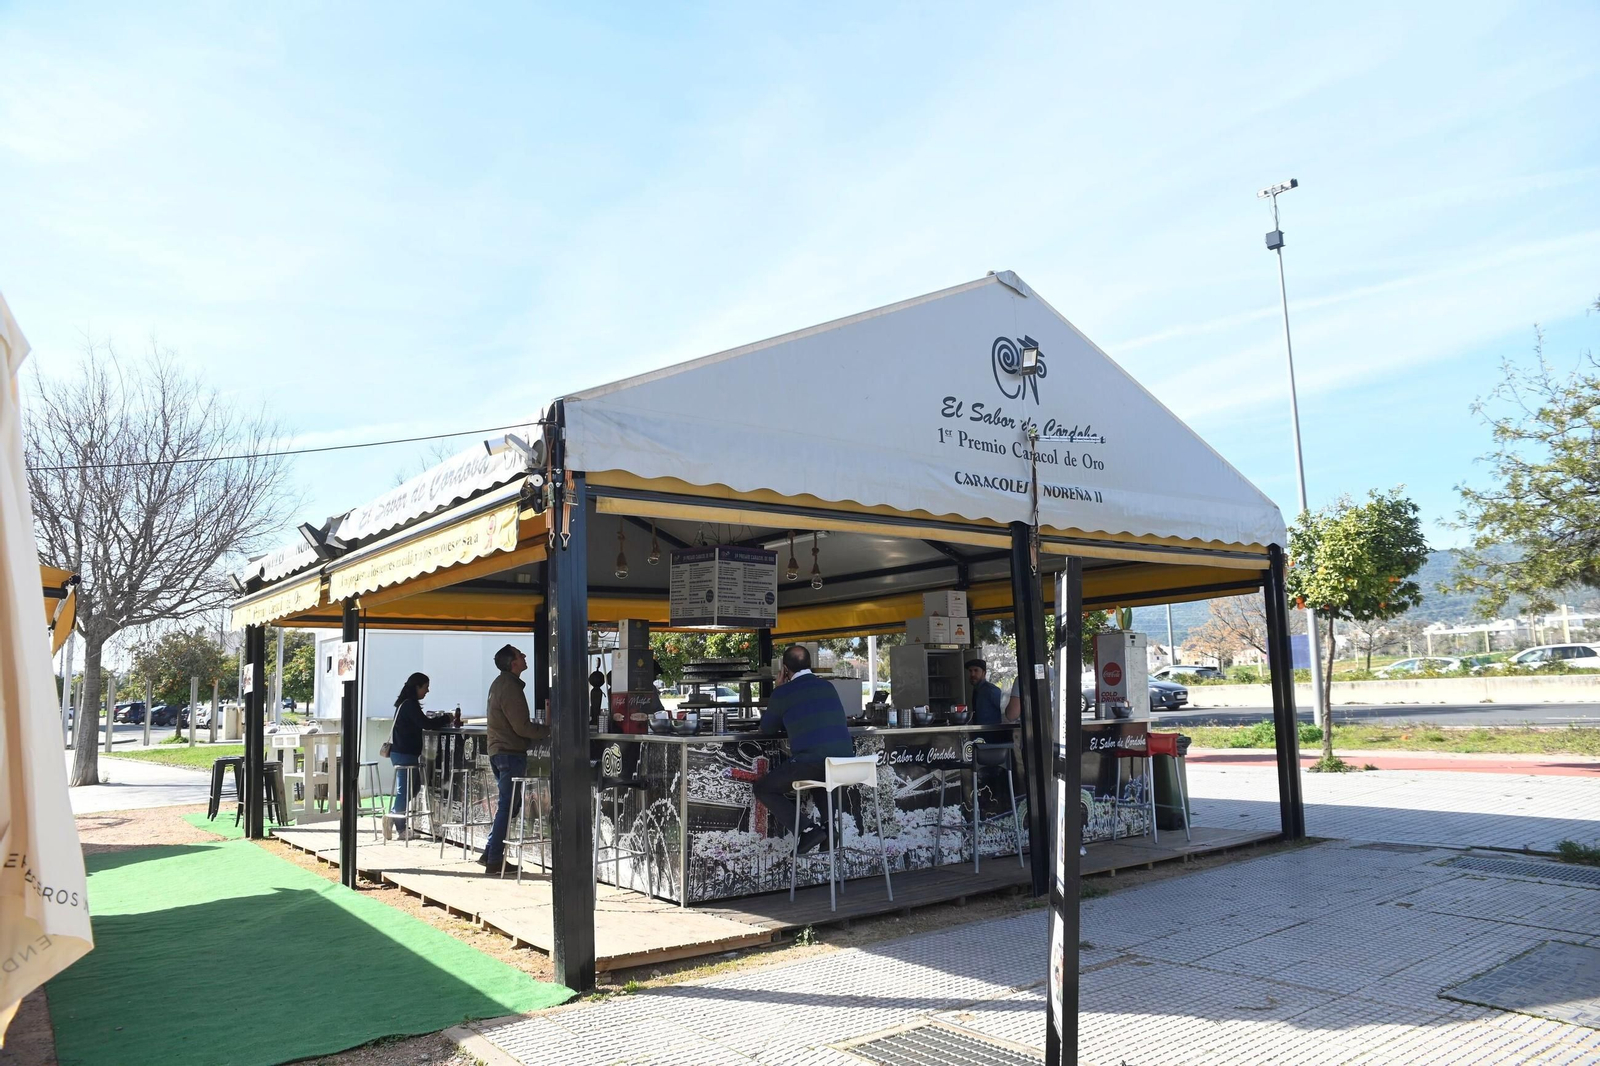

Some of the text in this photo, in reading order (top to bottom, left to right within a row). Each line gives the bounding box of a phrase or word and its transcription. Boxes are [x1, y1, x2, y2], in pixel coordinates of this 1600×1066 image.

[941, 396, 963, 418] El
[969, 402, 1016, 429] Sabor
[957, 430, 1006, 456] Premio
[1012, 441, 1058, 465] Caracol
[1064, 450, 1077, 467] de
[1082, 453, 1105, 470] Oro
[954, 471, 1029, 494] CARACOLES
[1042, 484, 1092, 502] NOREÑA
[889, 749, 913, 764] Sabor
[915, 750, 925, 762] de
[926, 747, 956, 764] Córdoba
[1090, 734, 1147, 751] El Sabor de Córdoba
